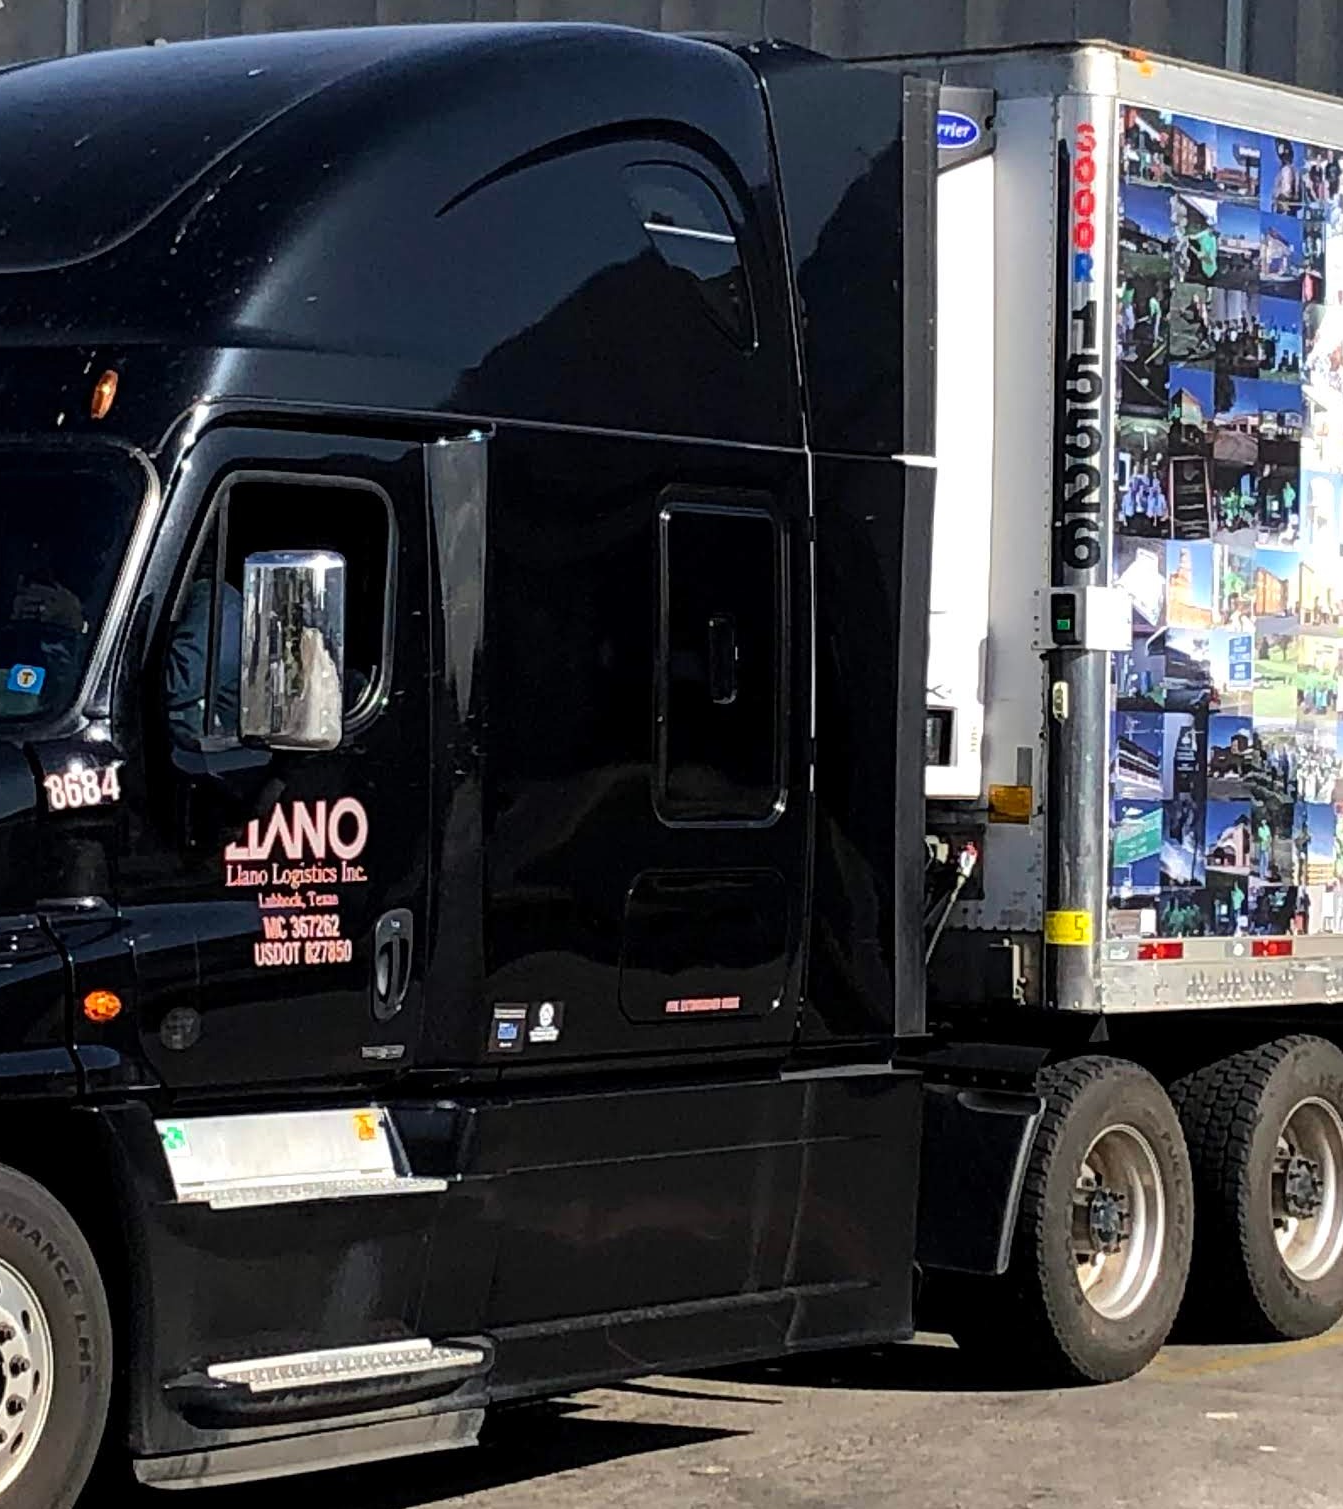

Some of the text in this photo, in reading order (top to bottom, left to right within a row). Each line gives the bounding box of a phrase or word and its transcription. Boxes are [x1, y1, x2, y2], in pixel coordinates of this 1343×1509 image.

[937, 122, 970, 138] rrier
[1065, 300, 1103, 569] 15526
[43, 766, 121, 810] 8684
[225, 797, 368, 860] LLANO
[225, 860, 368, 889] Llano Logistics Inc.
[262, 914, 340, 939] MC 367262
[254, 941, 301, 967] USDOT
